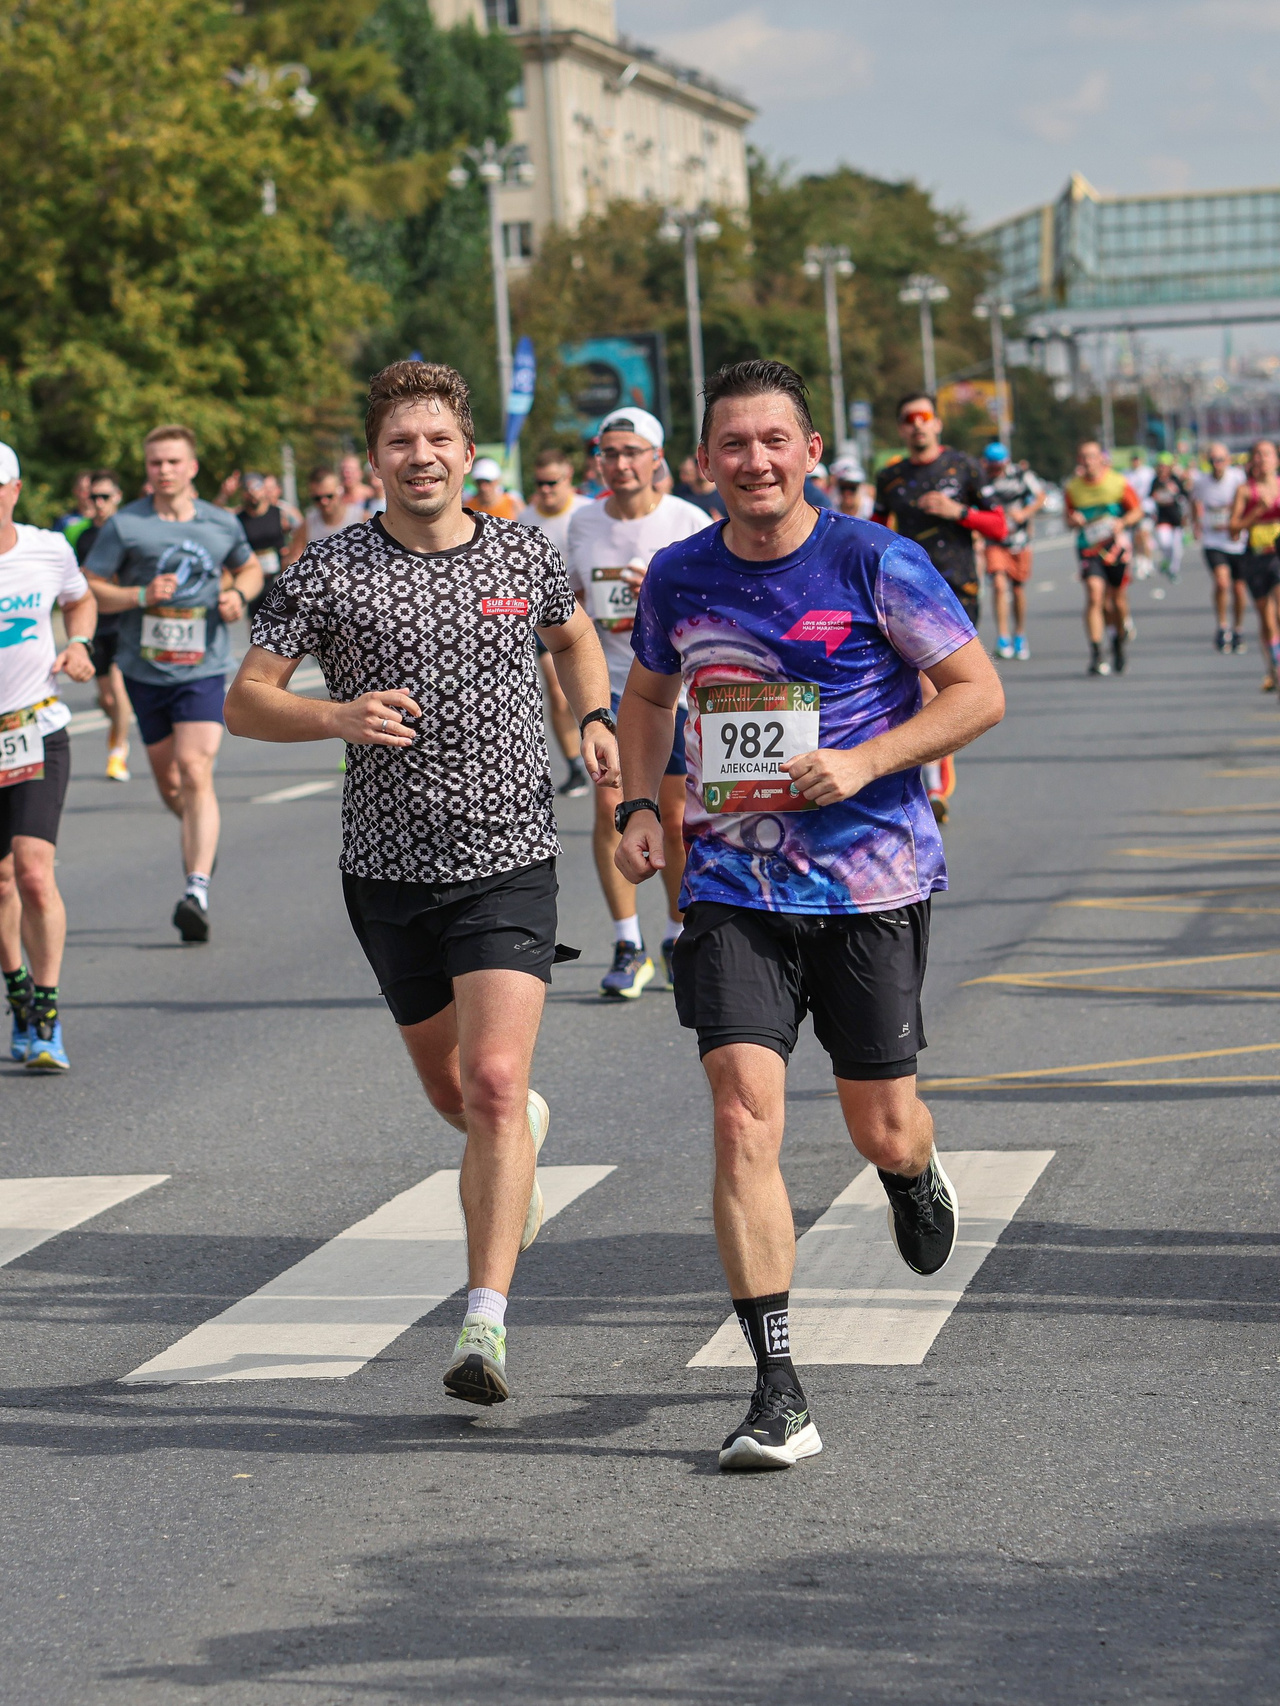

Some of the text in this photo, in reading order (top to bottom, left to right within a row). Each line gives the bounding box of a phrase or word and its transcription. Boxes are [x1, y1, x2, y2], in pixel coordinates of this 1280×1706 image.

[486, 599, 503, 607] SUB
[609, 586, 633, 605] 48
[720, 721, 785, 760] 982
